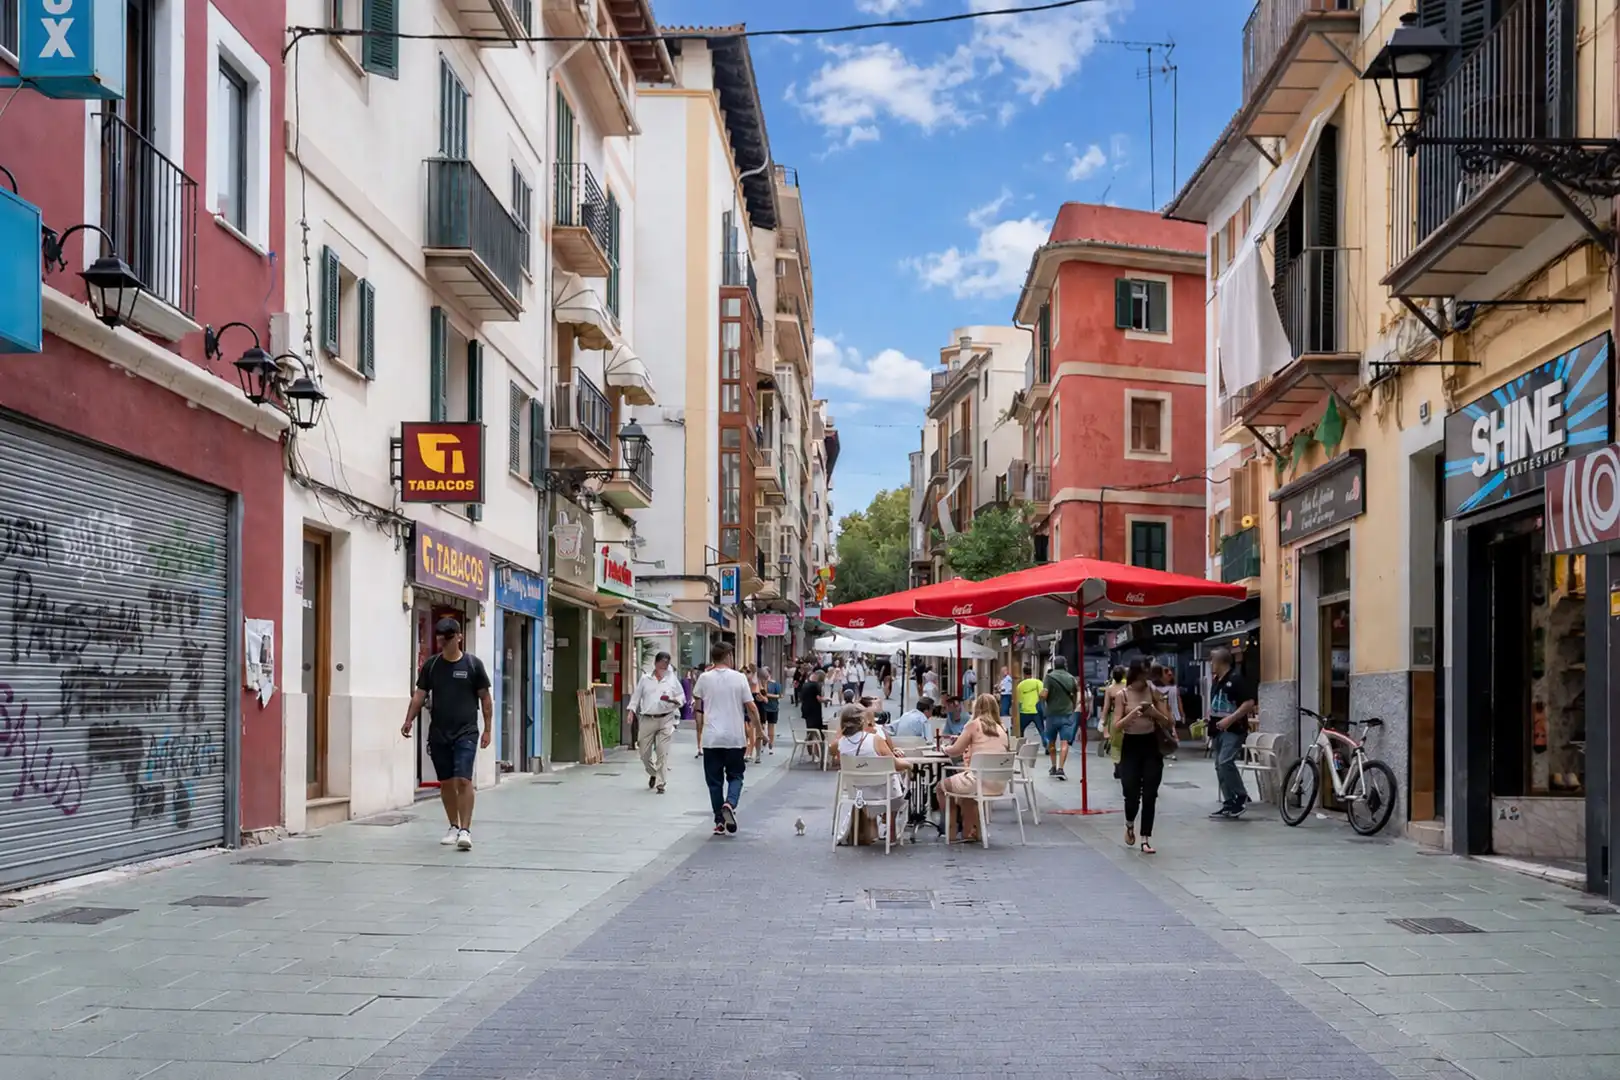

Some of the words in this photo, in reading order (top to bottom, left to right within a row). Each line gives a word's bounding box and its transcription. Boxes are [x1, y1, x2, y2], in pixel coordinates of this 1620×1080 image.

[1471, 379, 1564, 478] SHINE
[1503, 447, 1565, 479] SKATESHOP
[408, 480, 475, 491] TABACOS
[436, 542, 484, 586] TABACOS
[1152, 621, 1208, 636] RAMEN
